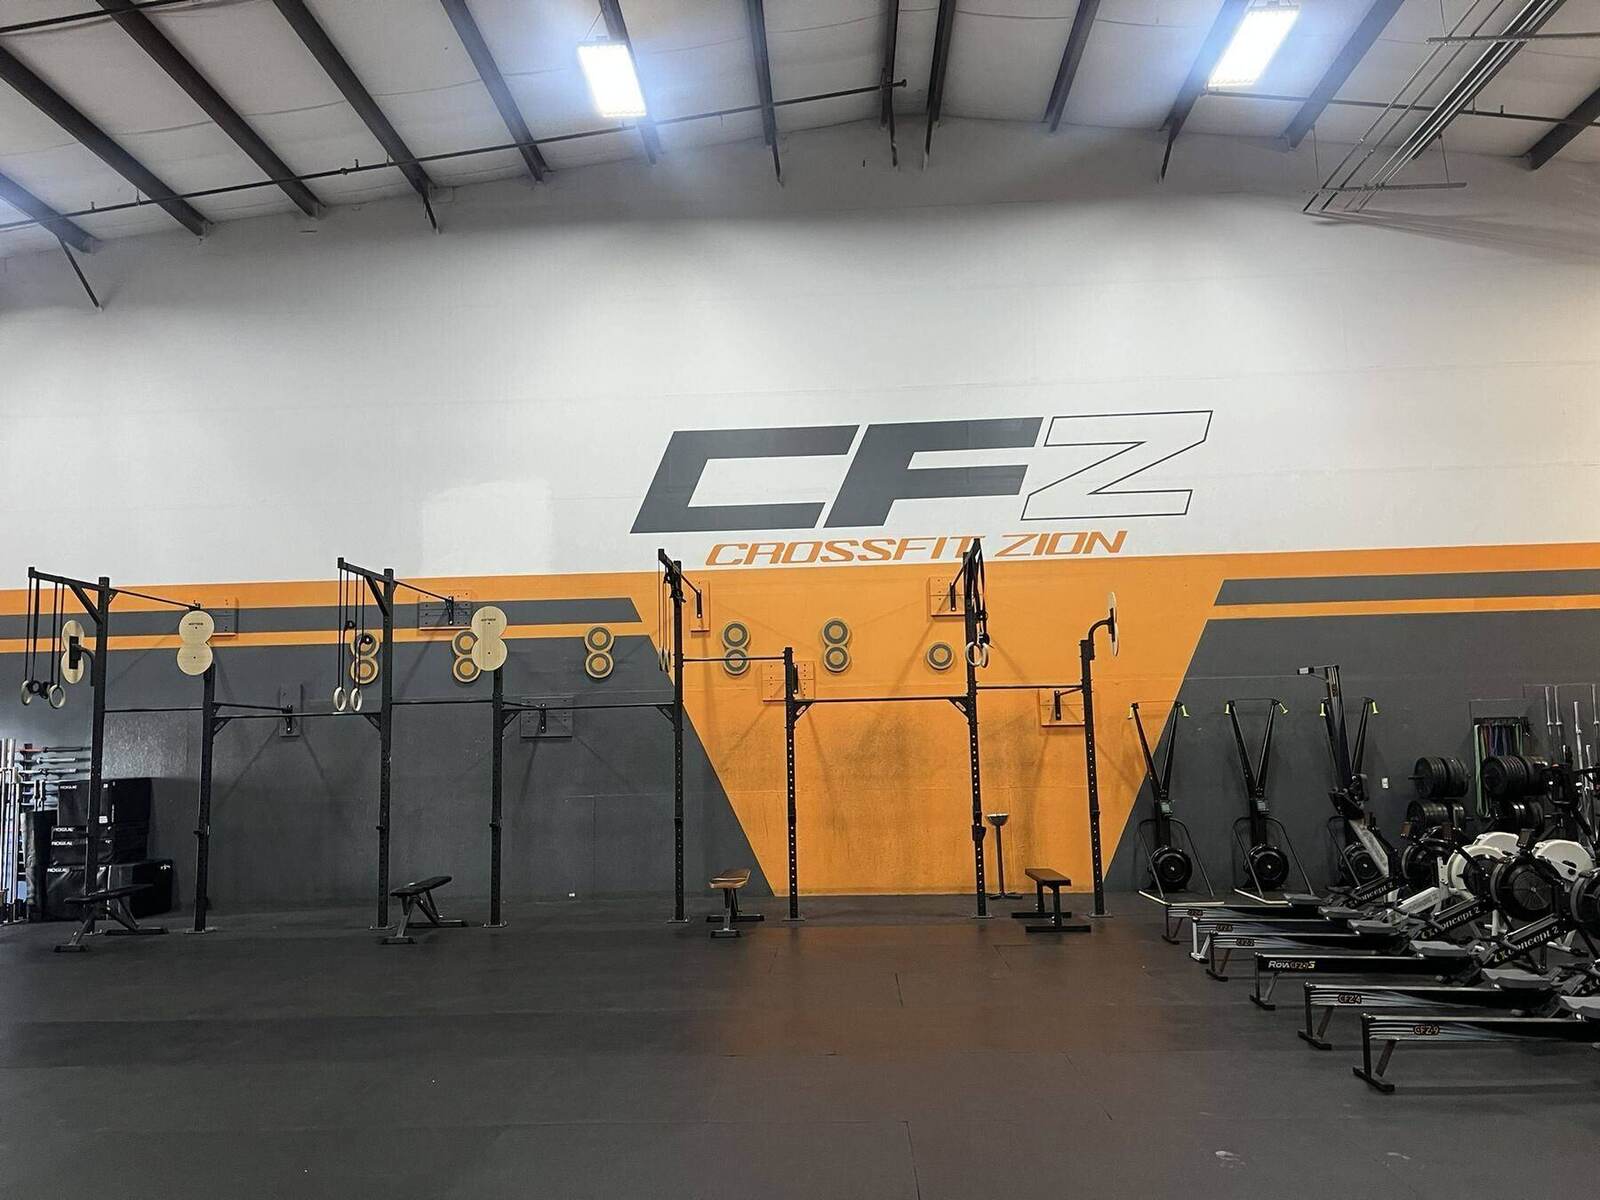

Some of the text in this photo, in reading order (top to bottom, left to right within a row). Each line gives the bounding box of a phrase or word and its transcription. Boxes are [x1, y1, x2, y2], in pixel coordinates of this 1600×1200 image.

[630, 410, 1212, 533] CFZ
[705, 530, 1128, 566] CROSSFIT ZION
[1414, 1025, 1439, 1035] CFZ-9
